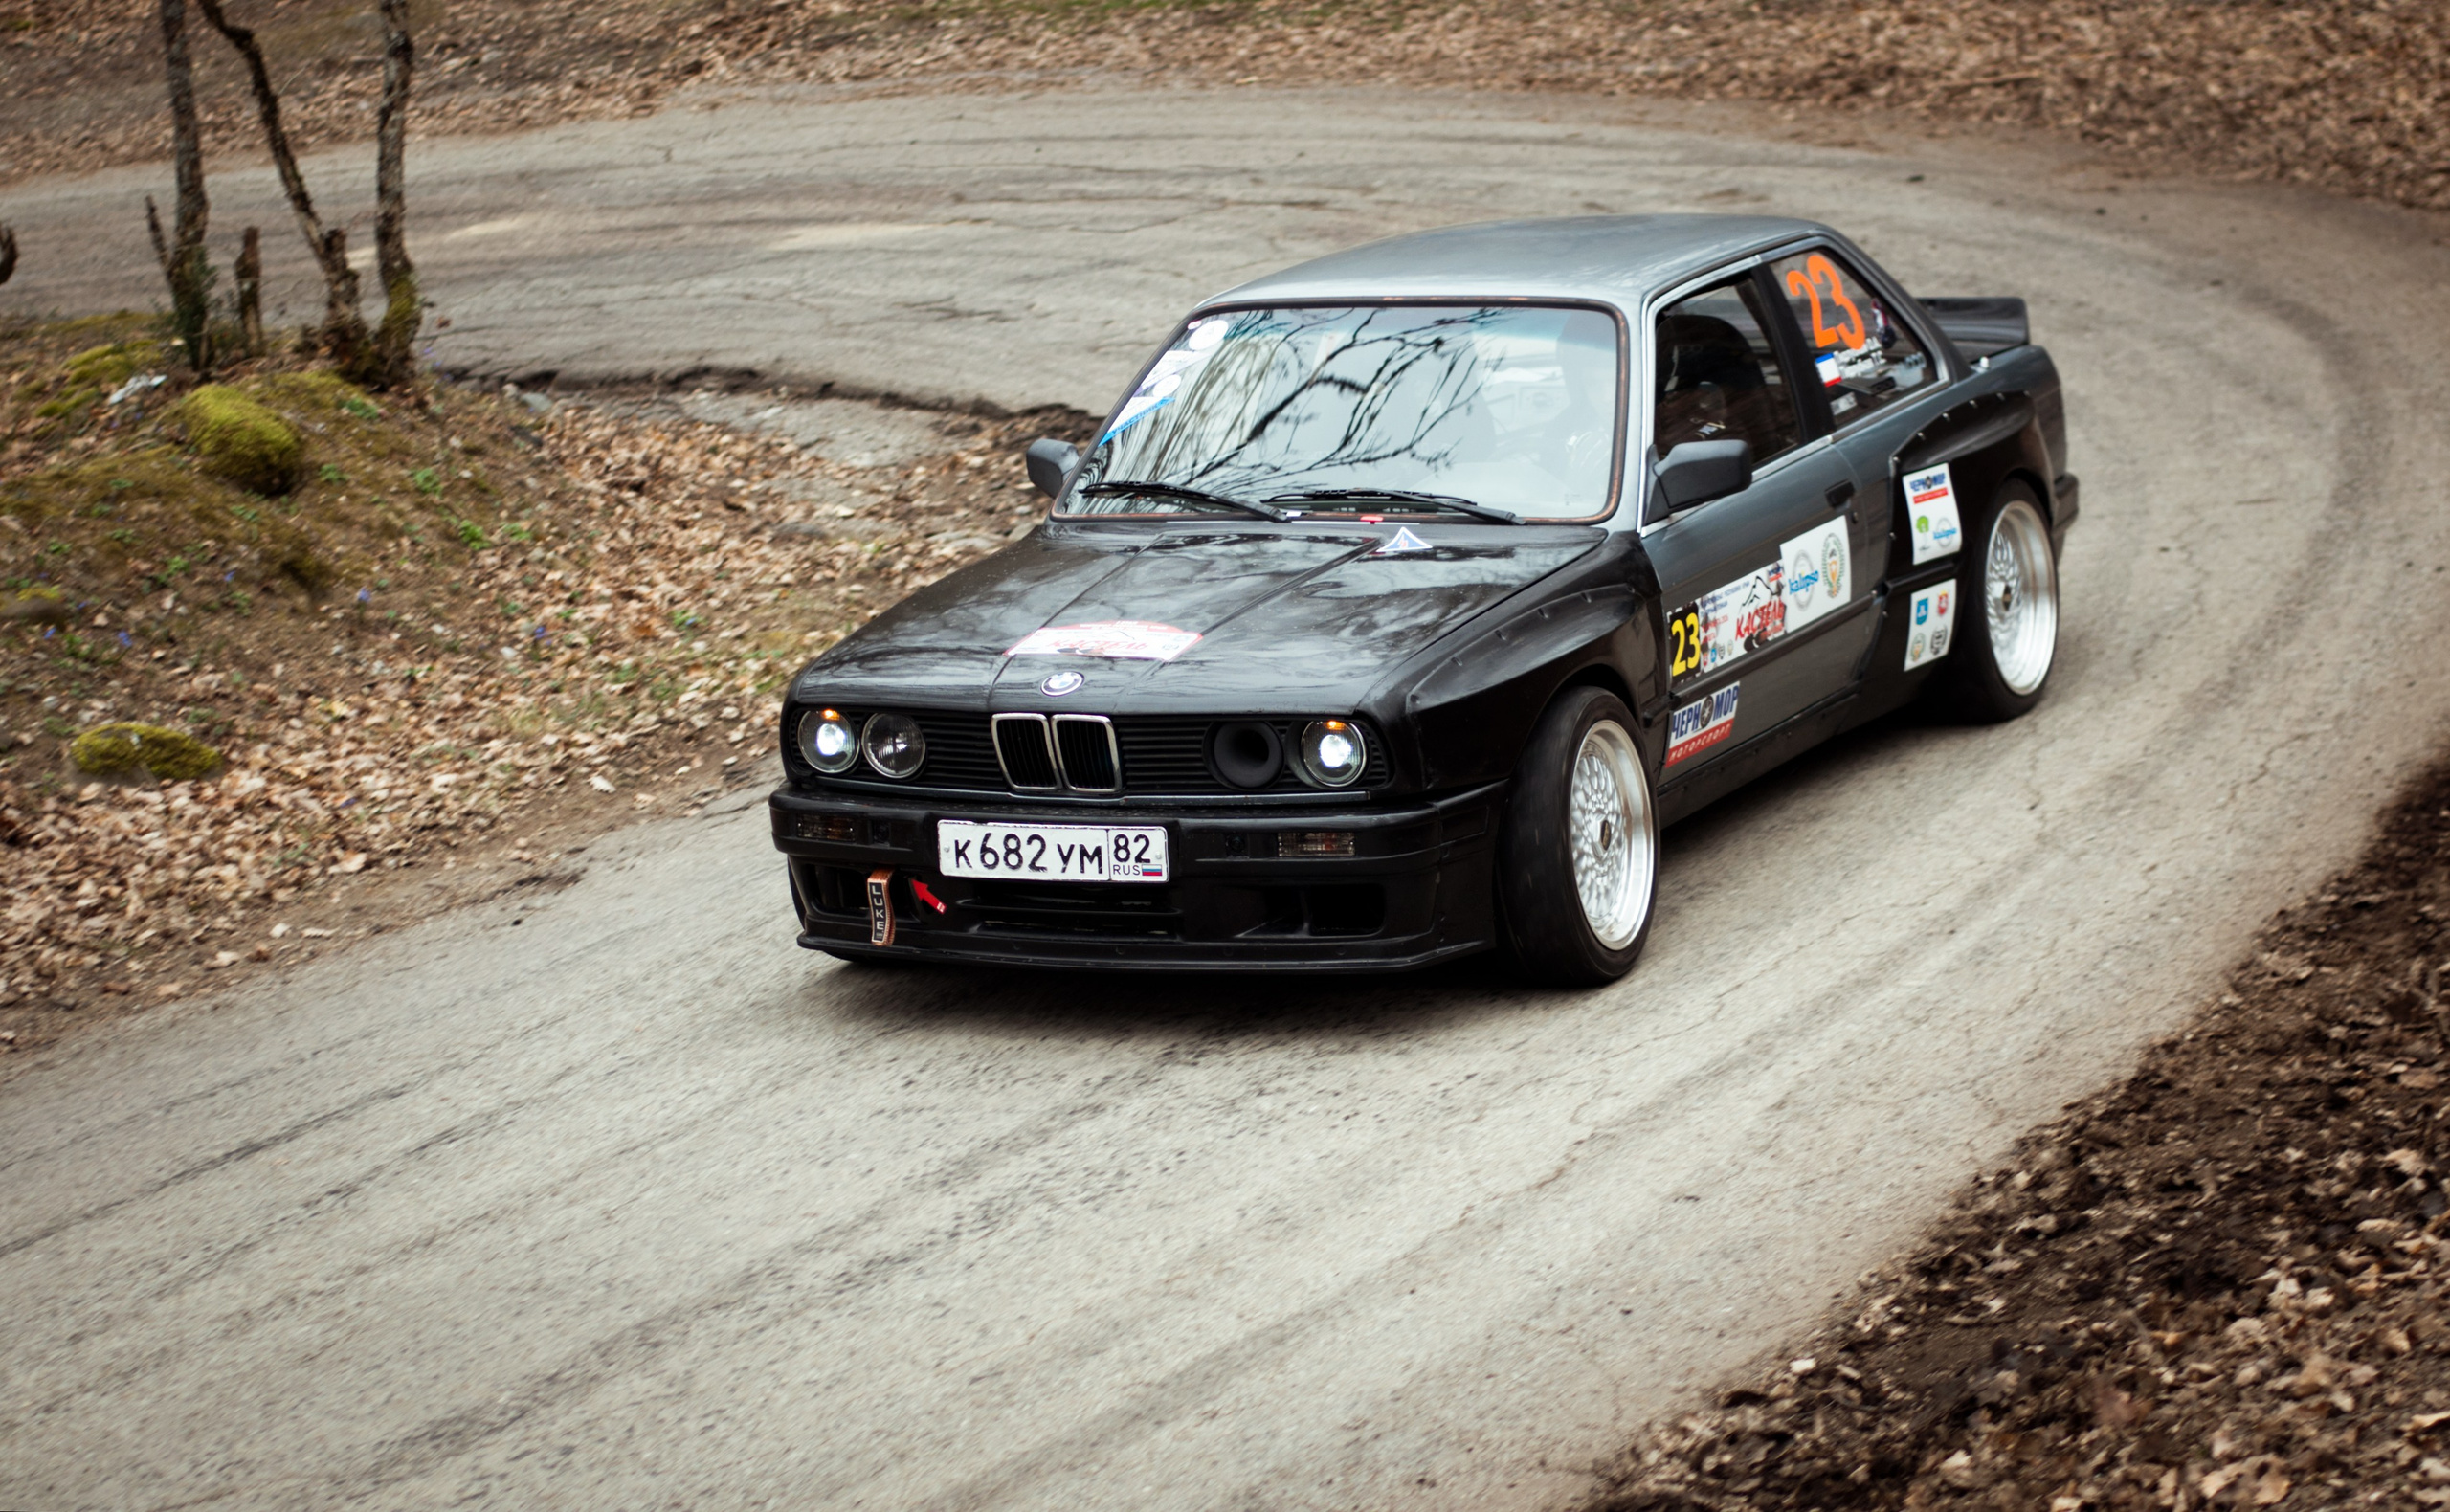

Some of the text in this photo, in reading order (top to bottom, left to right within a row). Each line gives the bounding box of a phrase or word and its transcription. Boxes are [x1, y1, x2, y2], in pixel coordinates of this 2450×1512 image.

[1786, 255, 1866, 350] 23
[1671, 612, 1701, 677] 23
[1669, 723, 1731, 762] МОТОРСПОРТ
[1112, 834, 1151, 863] 82
[1112, 864, 1141, 876] RUS
